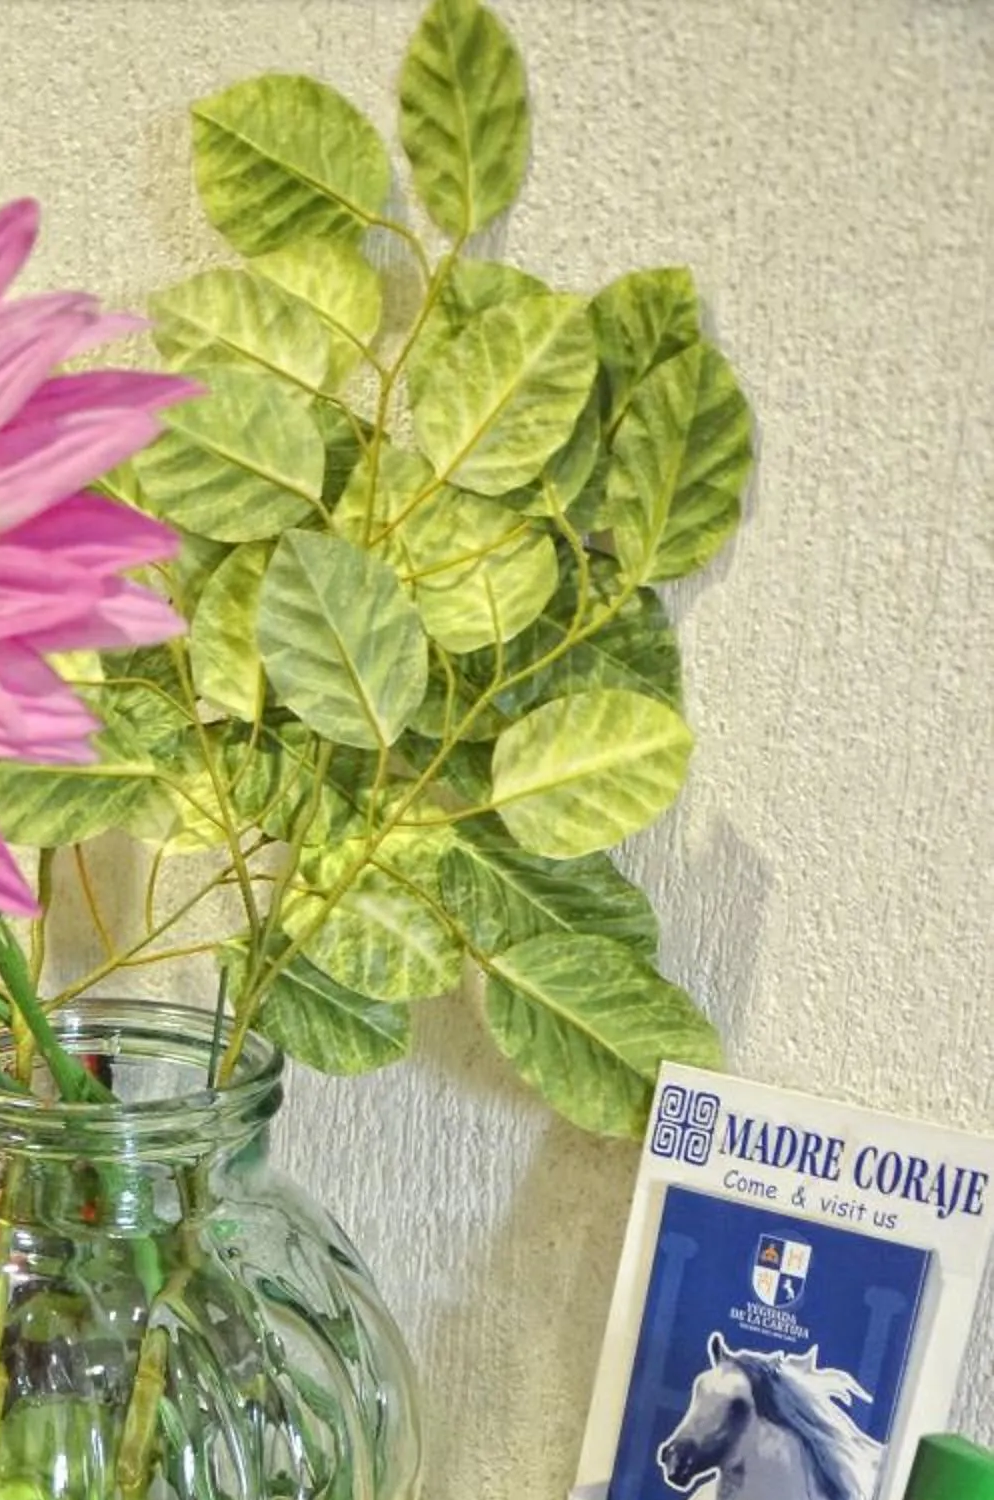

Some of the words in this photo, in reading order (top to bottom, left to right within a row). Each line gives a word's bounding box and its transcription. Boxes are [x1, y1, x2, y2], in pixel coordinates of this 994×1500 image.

[718, 1112, 846, 1183] MADRE
[853, 1145, 989, 1219] CORAJE
[723, 1169, 778, 1200] Come
[791, 1186, 806, 1208] &
[821, 1194, 867, 1221] visit
[872, 1209, 898, 1230] us
